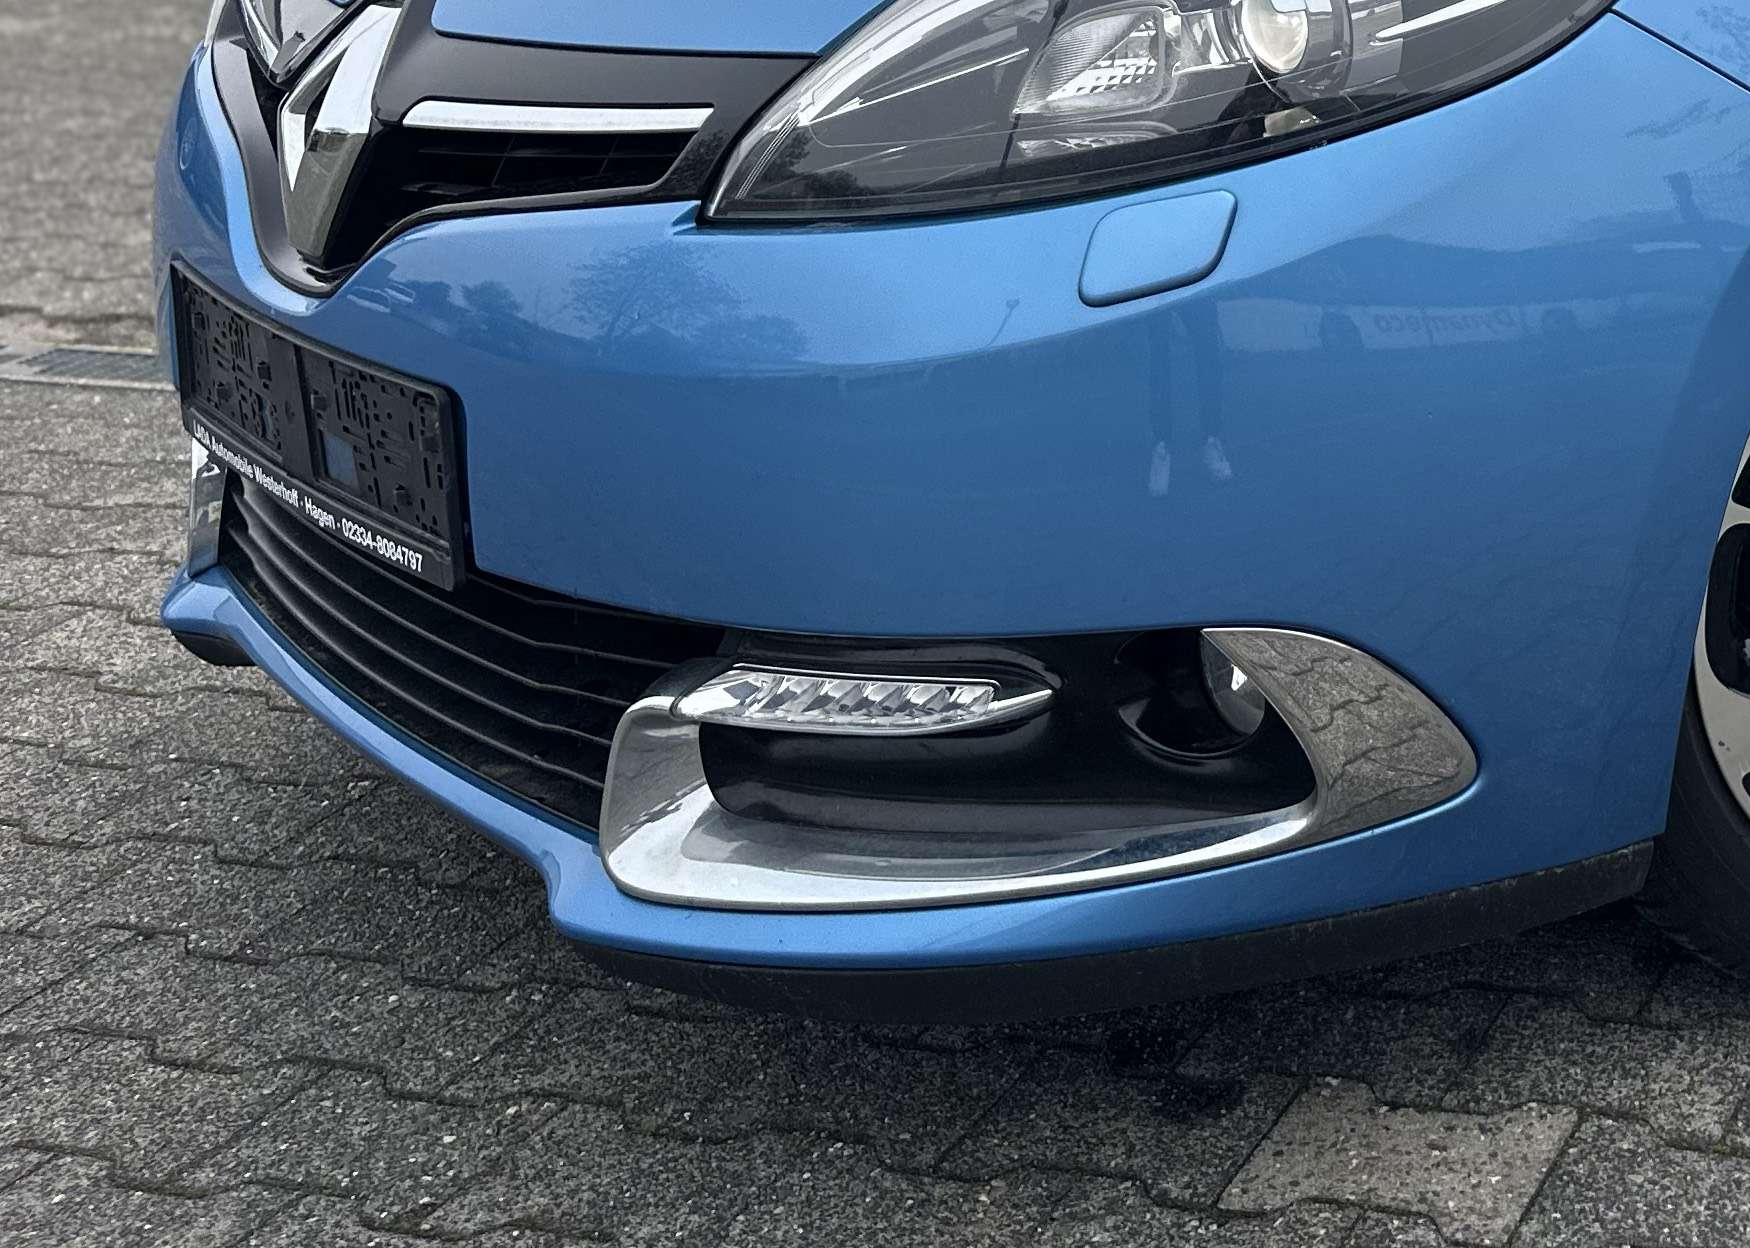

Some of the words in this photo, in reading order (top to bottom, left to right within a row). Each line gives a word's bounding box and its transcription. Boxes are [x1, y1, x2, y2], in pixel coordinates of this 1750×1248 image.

[212, 436, 253, 479] Automobile
[304, 496, 335, 530] Hagen
[342, 518, 422, 572] 02334-8084797
